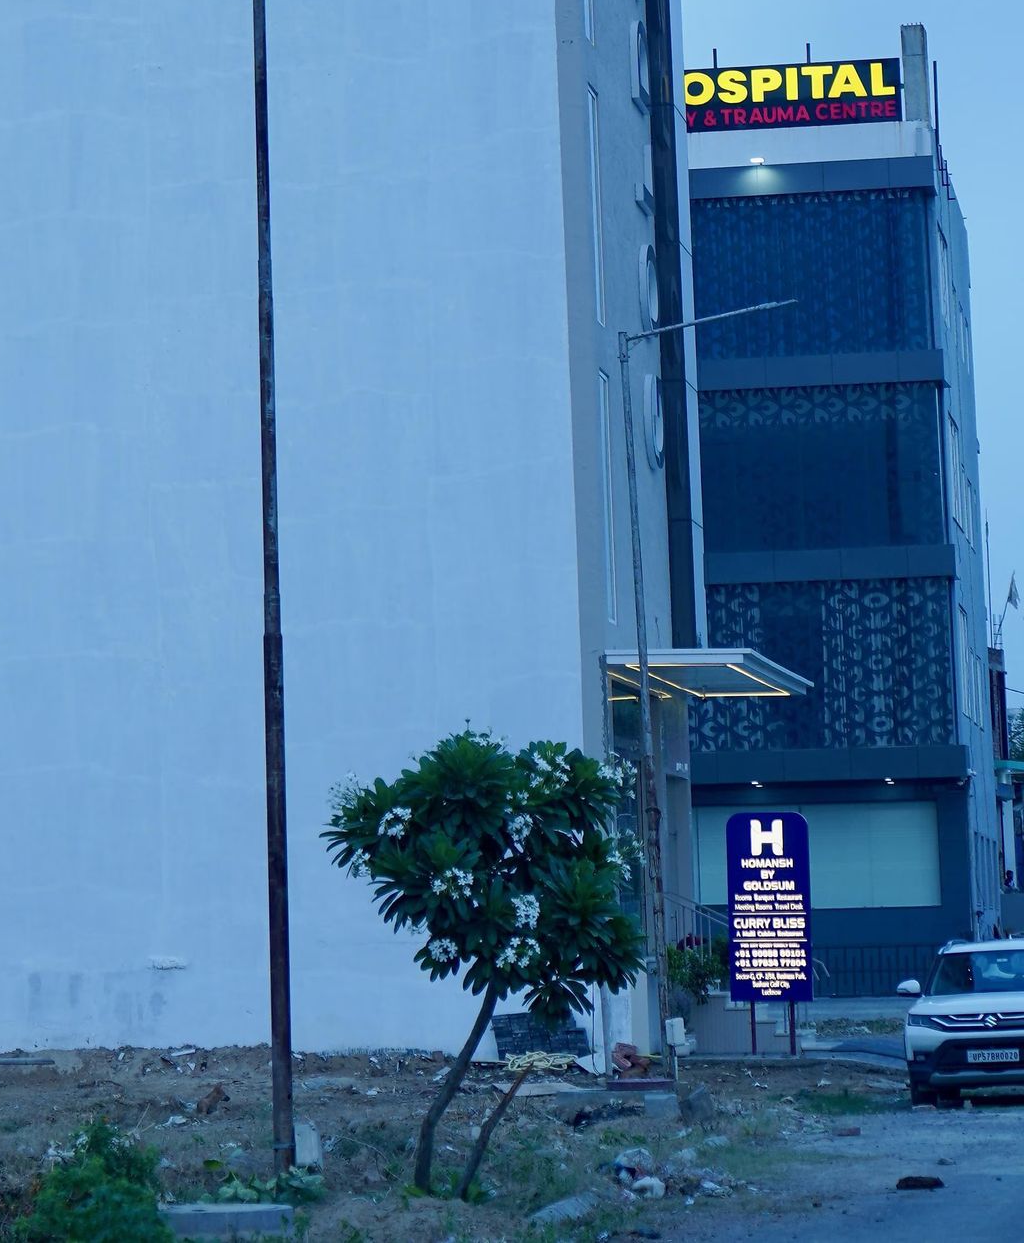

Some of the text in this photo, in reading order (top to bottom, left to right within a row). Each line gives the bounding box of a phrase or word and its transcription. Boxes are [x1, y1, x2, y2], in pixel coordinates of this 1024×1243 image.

[684, 63, 896, 106] OSPITAL
[704, 109, 717, 126] &
[720, 105, 810, 126] TRAUMA
[816, 100, 896, 119] CENTRE
[741, 858, 793, 868] HOMANSH
[760, 870, 775, 880] BY
[743, 881, 795, 891] GOLDSUM
[735, 903, 755, 912] Meeting
[775, 902, 790, 910] Travel
[733, 917, 806, 929] CURRY BLISS
